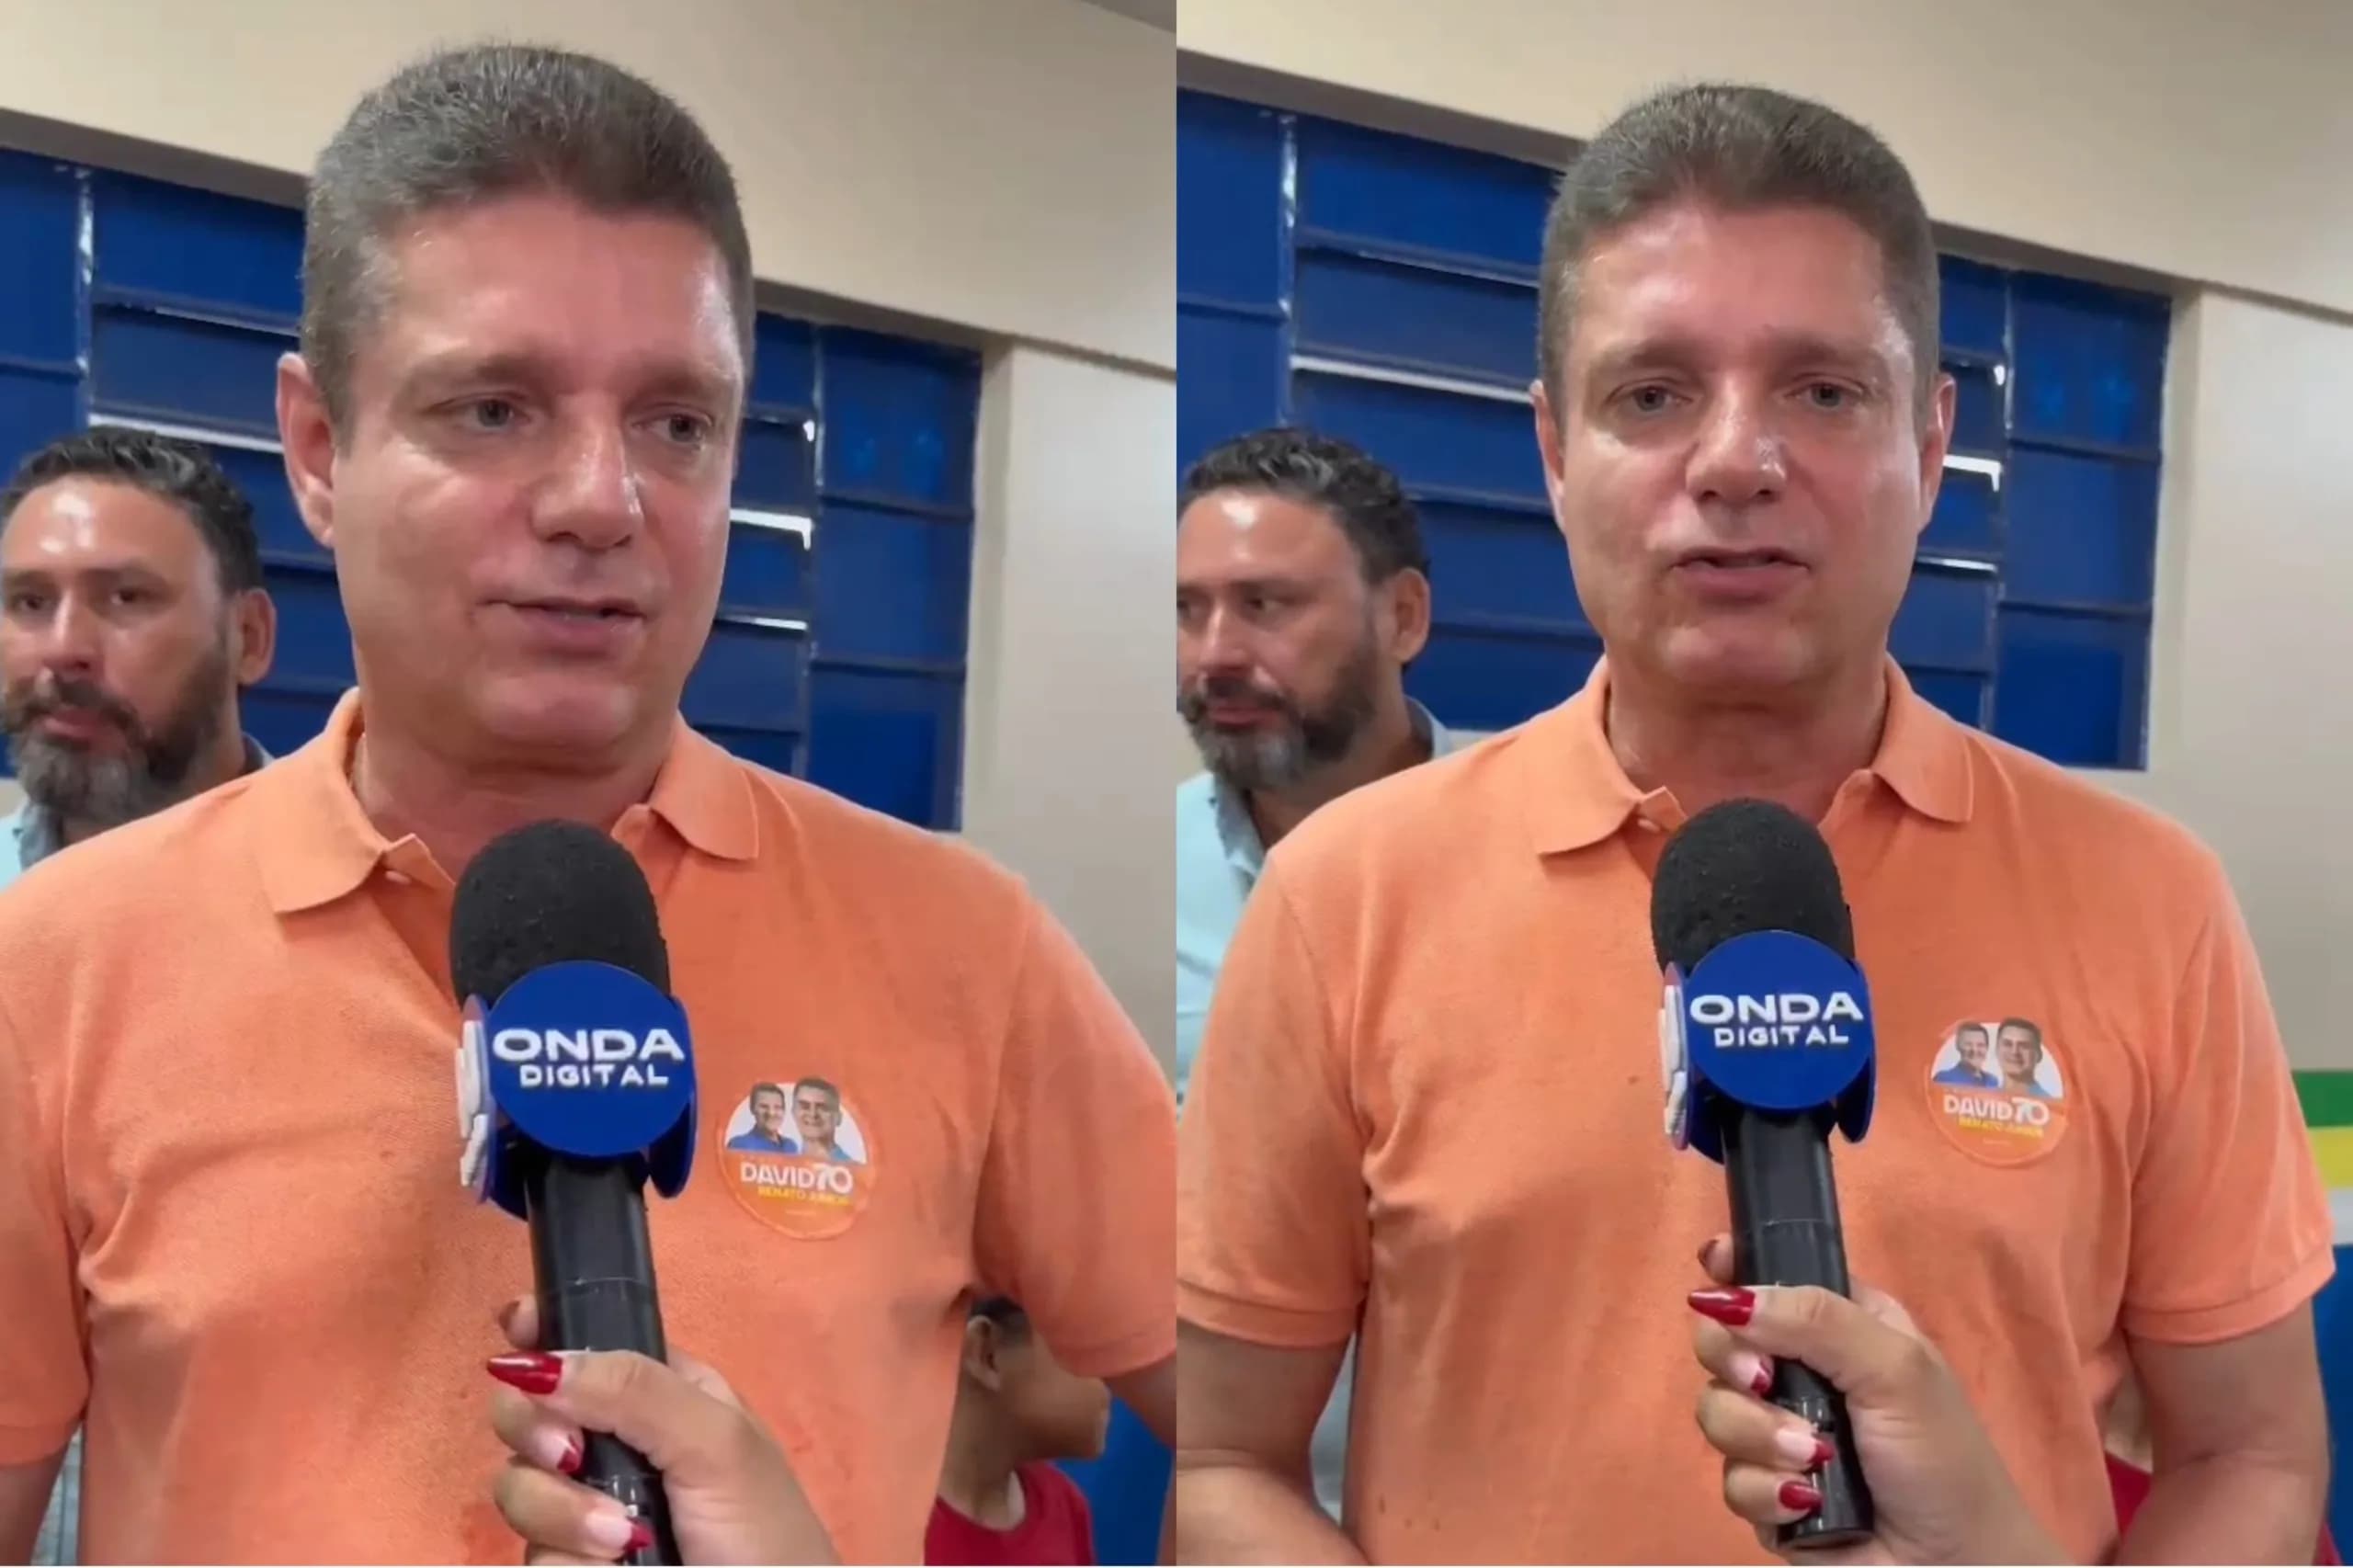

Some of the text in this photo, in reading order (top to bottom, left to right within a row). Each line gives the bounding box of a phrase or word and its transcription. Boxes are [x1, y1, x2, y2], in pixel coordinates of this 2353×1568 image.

[1690, 992, 1863, 1023] ONDA
[494, 1028, 685, 1061] ONDA
[1714, 1025, 1848, 1047] DIGITAL
[519, 1064, 668, 1086] DIGITAL
